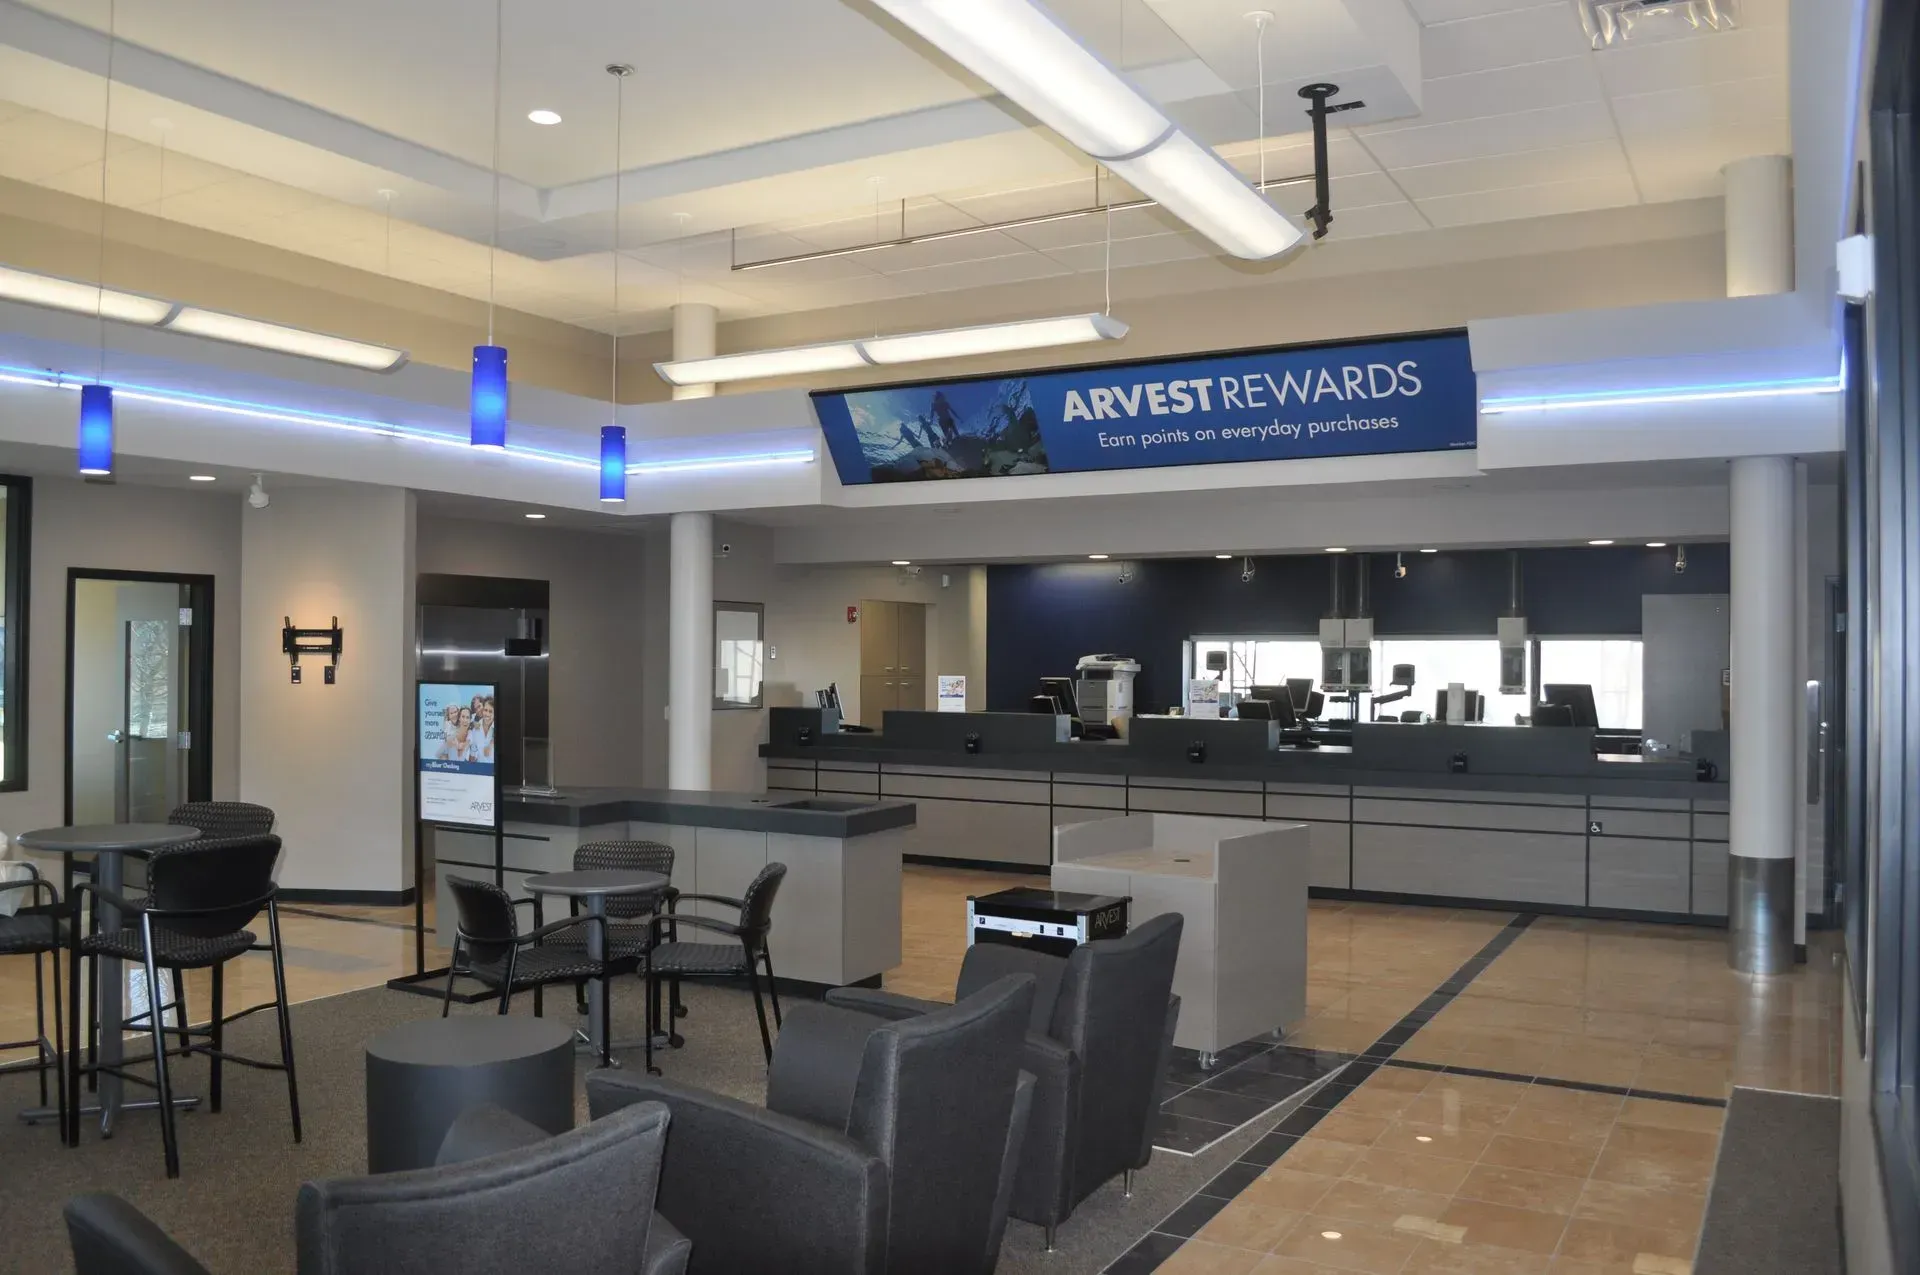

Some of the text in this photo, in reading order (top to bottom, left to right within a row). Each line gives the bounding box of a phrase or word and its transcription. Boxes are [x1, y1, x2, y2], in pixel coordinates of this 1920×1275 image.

[1063, 360, 1423, 422] ARVEST REWARDS
[1099, 414, 1400, 449] Earn points on everyday purchases
[424, 698, 438, 707] Give
[470, 800, 493, 814] ARVEST
[1095, 906, 1121, 929] ARVEST
